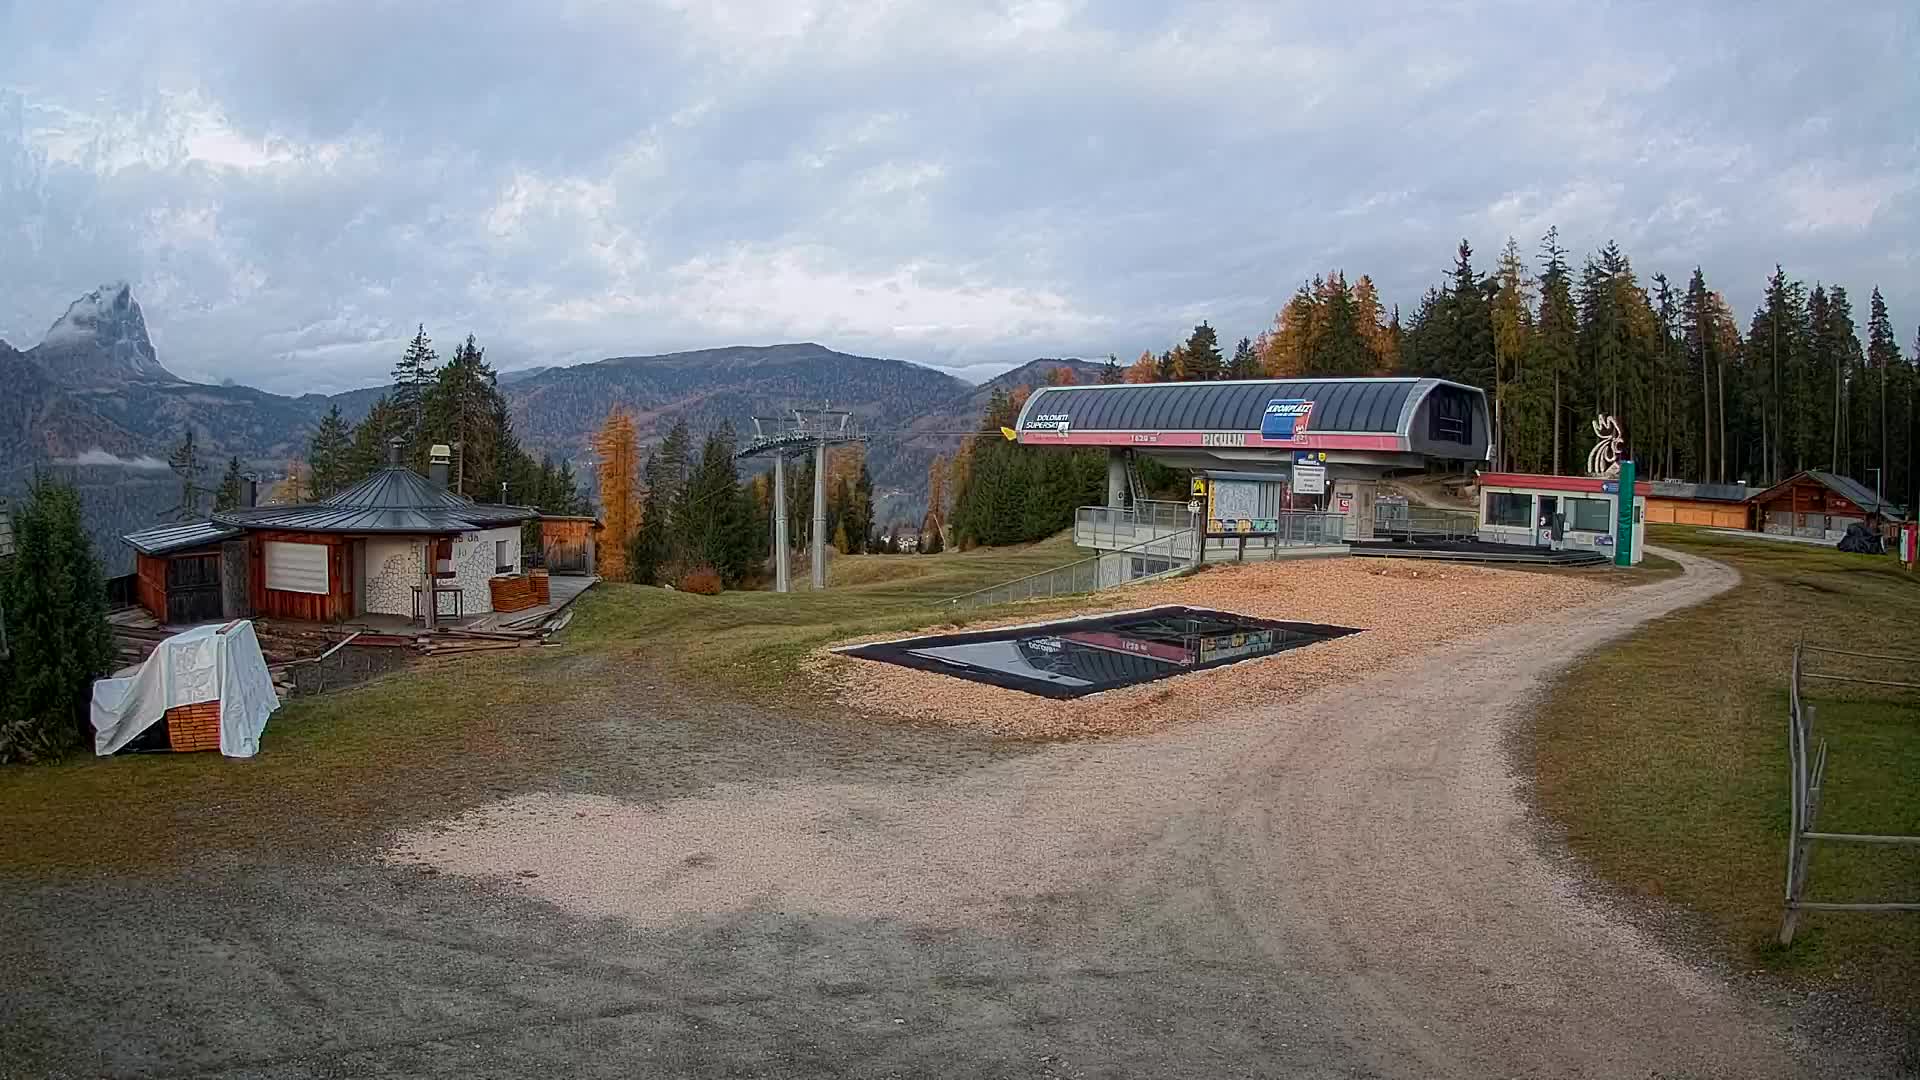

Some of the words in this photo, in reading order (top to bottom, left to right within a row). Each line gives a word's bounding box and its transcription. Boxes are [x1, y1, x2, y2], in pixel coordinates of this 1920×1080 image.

[1036, 414, 1069, 422] DOLOMITI
[1025, 421, 1059, 429] SUPERSKI
[1202, 433, 1245, 447] PICULIN
